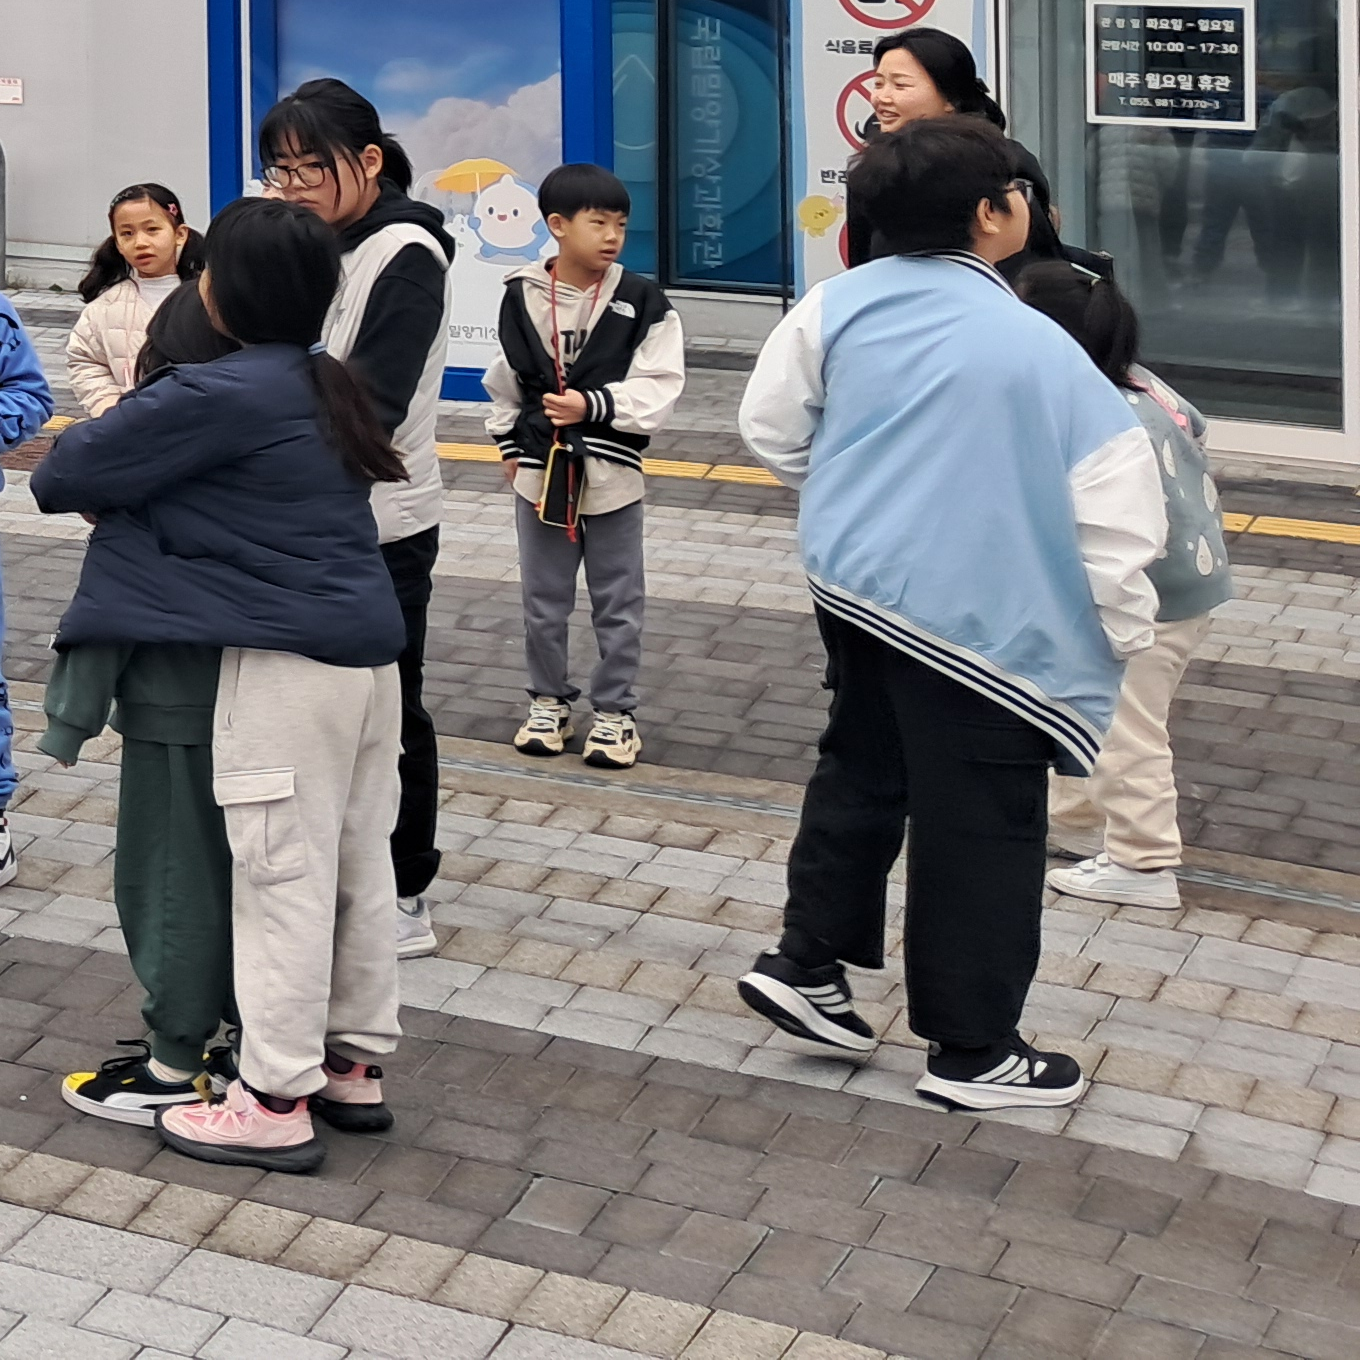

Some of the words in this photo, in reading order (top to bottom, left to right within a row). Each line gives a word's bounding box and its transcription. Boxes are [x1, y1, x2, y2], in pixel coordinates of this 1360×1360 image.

[1146, 41, 1185, 53] 10:00
[1199, 43, 1240, 54] 17:30
[1108, 71, 1141, 89] 매주
[1144, 73, 1194, 91] 월요일
[1197, 74, 1233, 92] 휴관
[690, 15, 724, 270] 국립밀양기상과학관
